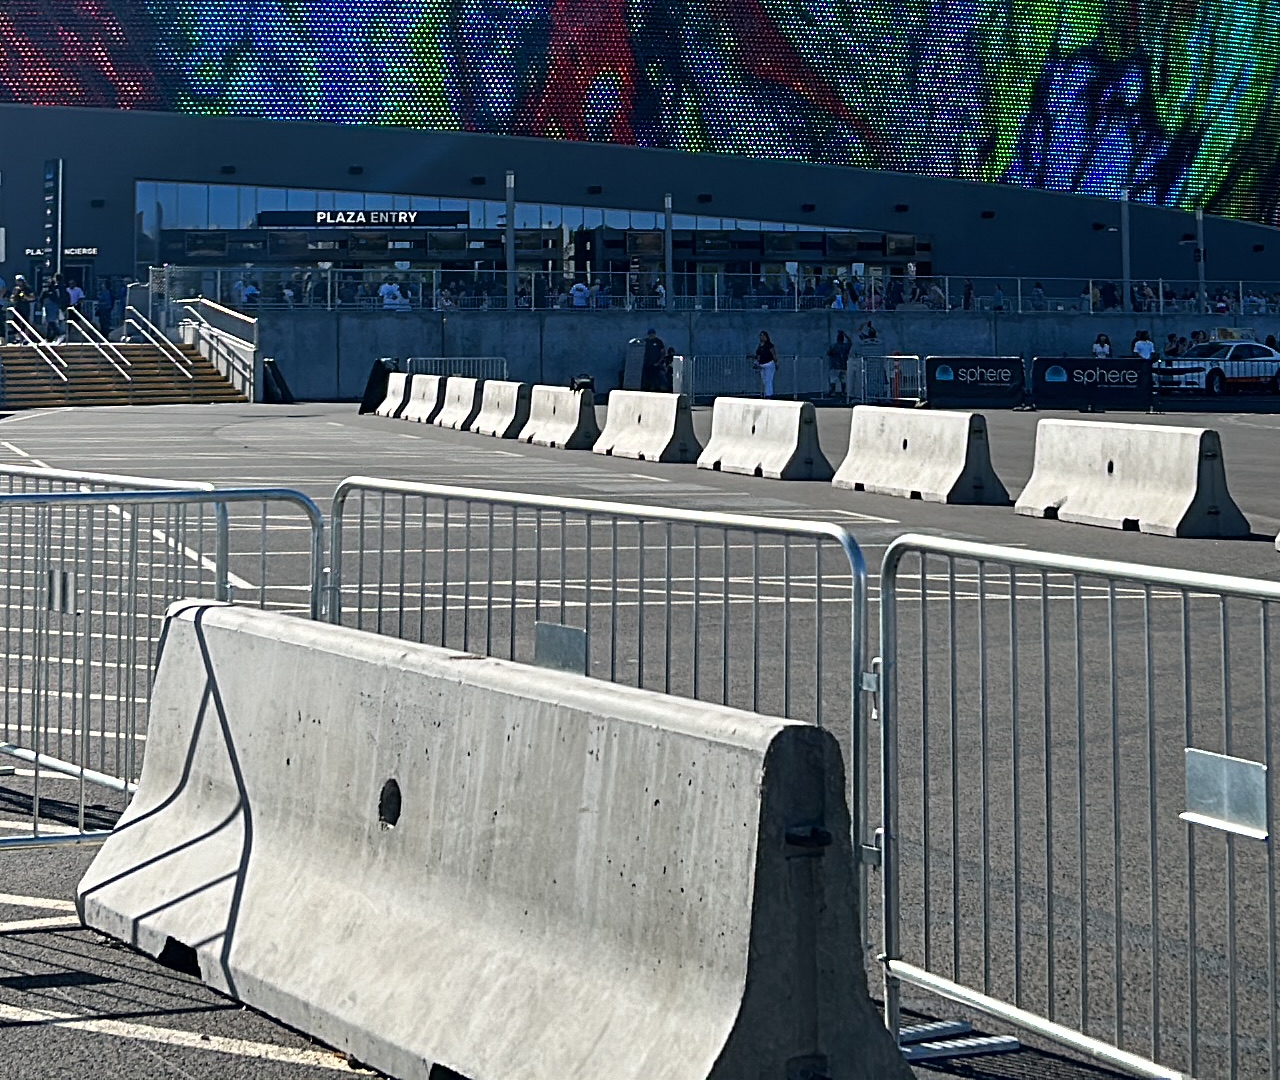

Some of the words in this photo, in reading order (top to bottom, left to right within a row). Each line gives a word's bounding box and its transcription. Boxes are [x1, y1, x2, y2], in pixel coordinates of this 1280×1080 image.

[316, 211, 366, 222] PLAZA
[370, 212, 417, 222] ENTRY
[958, 366, 1012, 384] sphere
[1073, 367, 1138, 385] sphere
